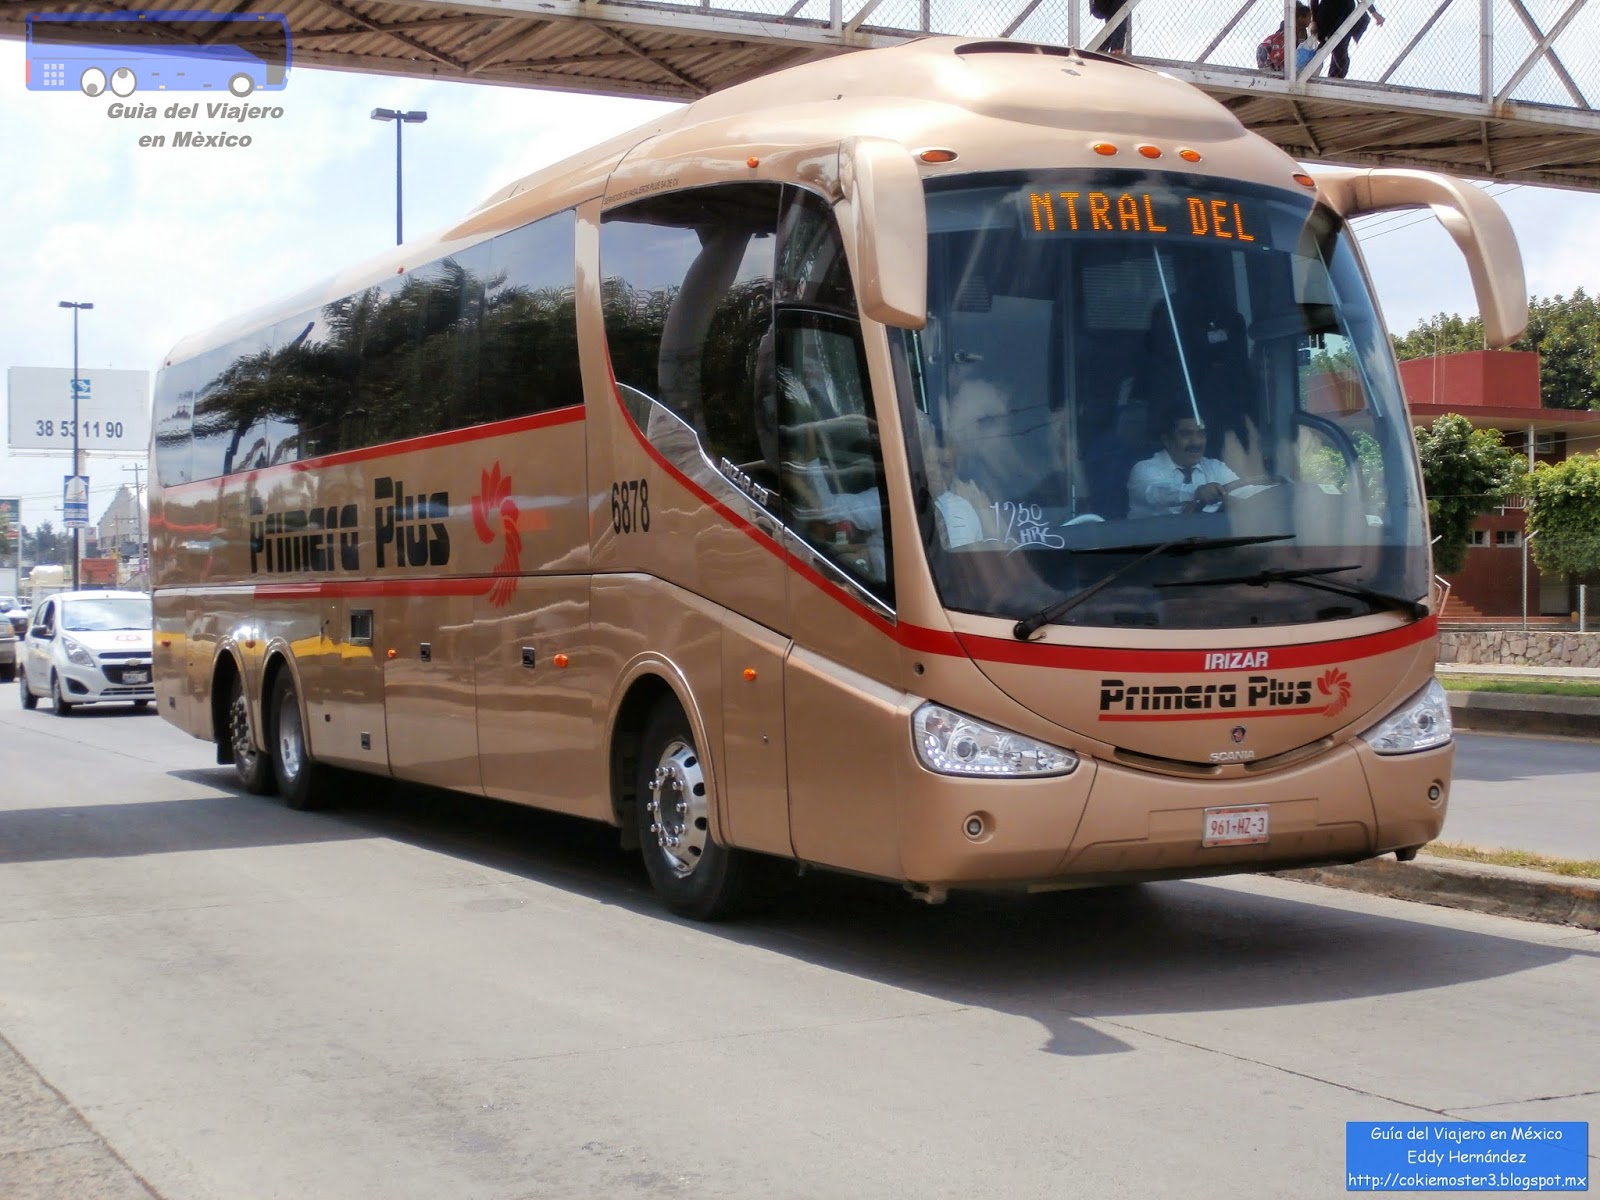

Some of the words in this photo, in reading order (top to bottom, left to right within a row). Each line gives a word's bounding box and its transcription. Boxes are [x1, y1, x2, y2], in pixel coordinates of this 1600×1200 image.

[1187, 197, 1255, 241] DEL
[36, 420, 54, 437] 38
[60, 420, 77, 437] 53
[83, 421, 100, 438] 11
[106, 421, 123, 438] 90
[611, 478, 650, 535] 6878
[250, 497, 360, 574] Primera
[374, 476, 450, 568] Plus
[1204, 651, 1269, 670] IRIZAR
[1100, 679, 1236, 711] Primera
[1248, 676, 1312, 706] Plus
[1209, 750, 1255, 762] SCANIA
[1211, 817, 1265, 836] 961-HZ-3
